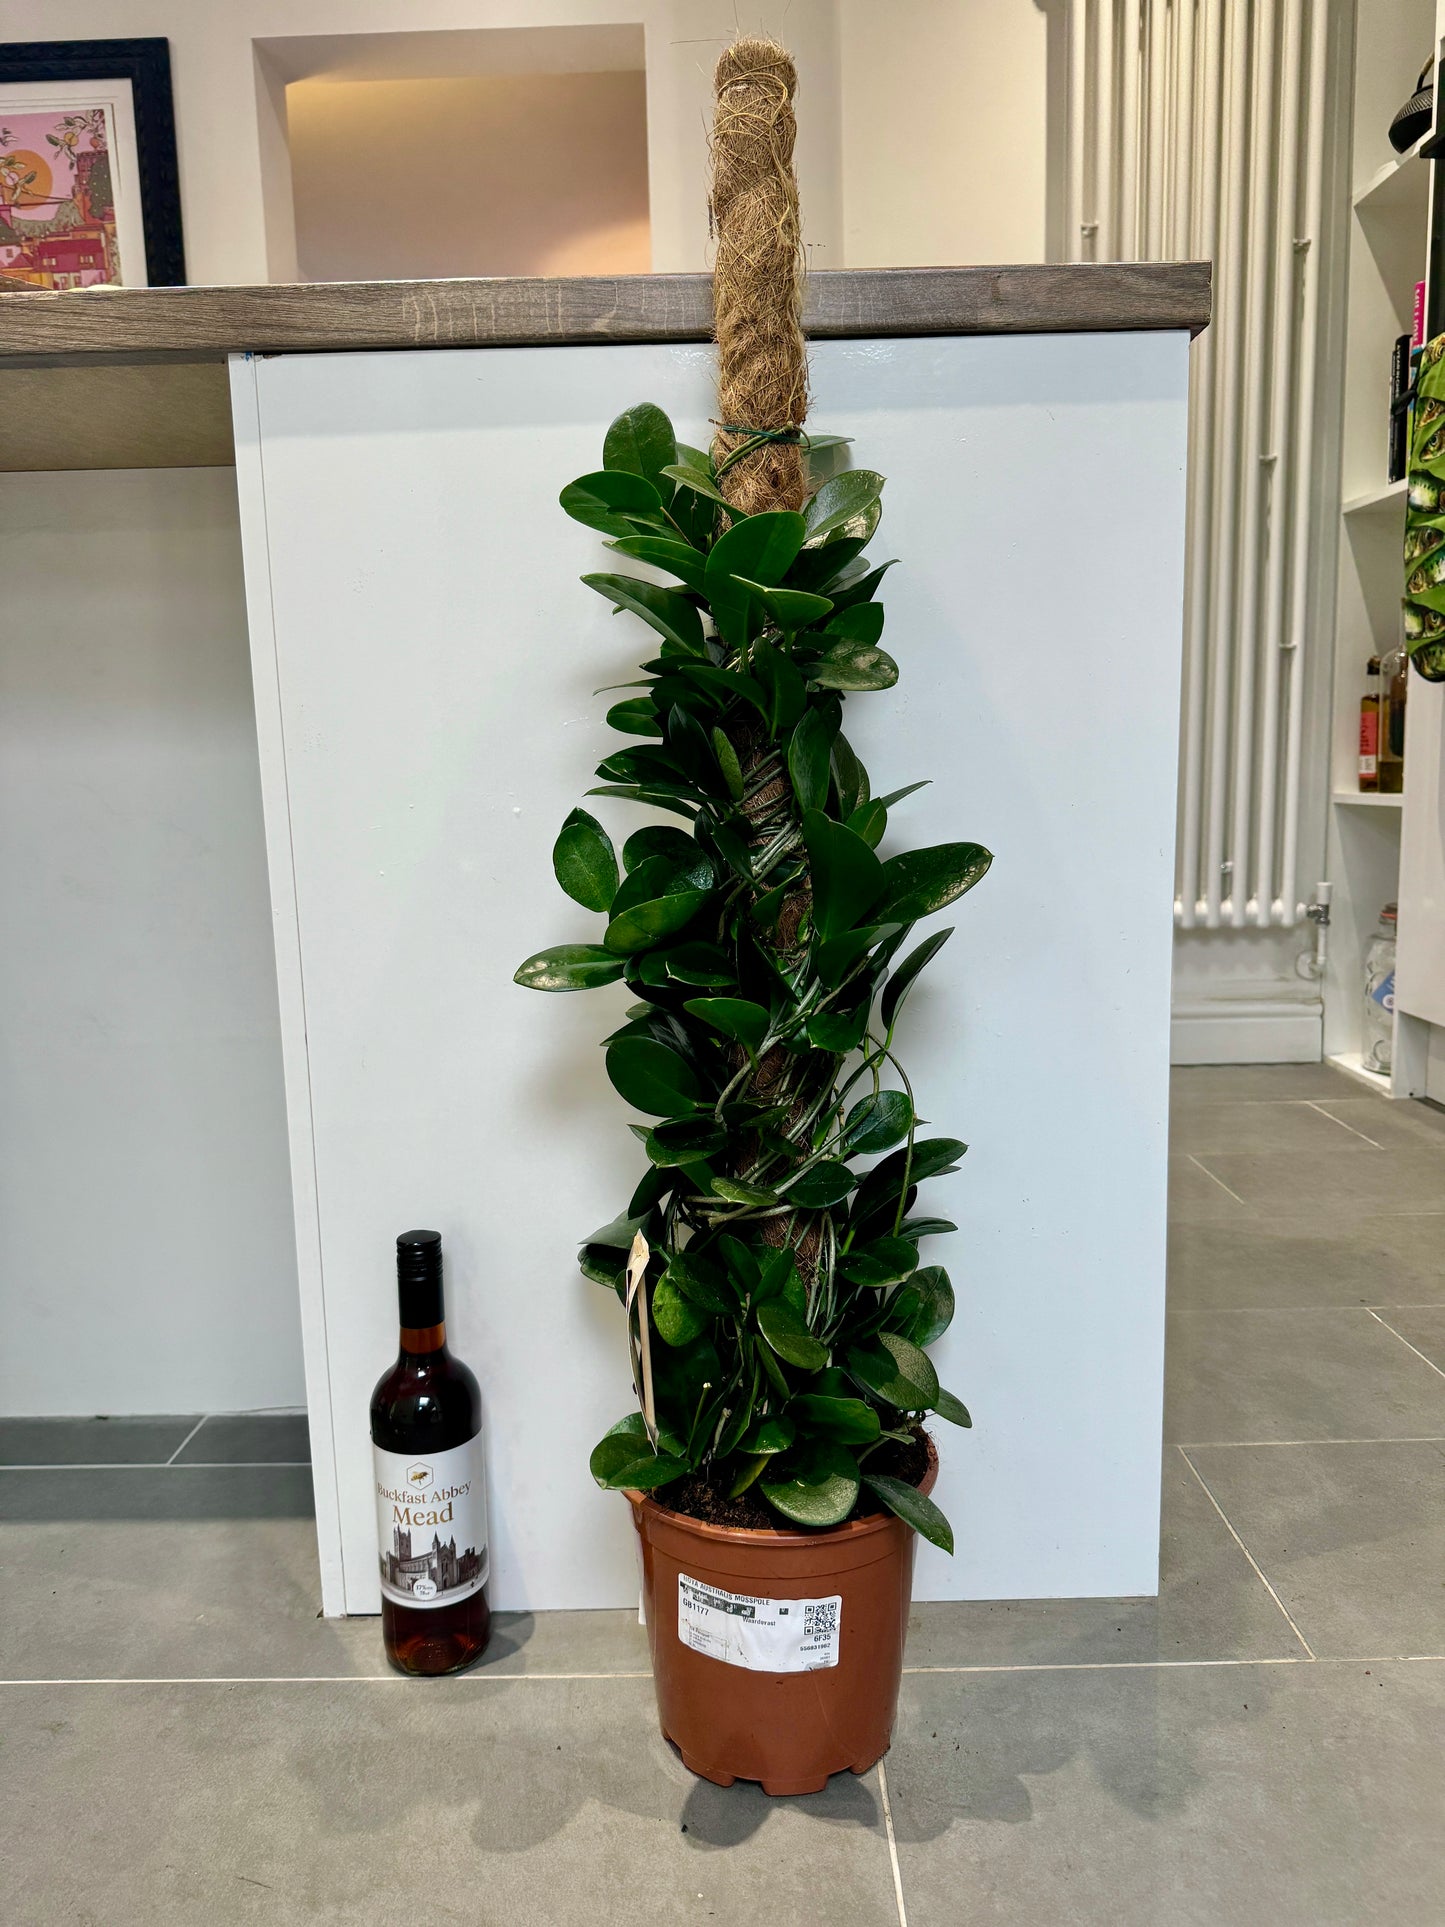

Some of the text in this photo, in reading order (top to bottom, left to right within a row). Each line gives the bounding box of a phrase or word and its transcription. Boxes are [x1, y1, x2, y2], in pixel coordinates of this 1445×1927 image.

[377, 1480, 471, 1504] Buckfast Abbey
[393, 1501, 454, 1526] Mead
[700, 1583, 733, 1600] AUSTRALIS
[734, 1595, 770, 1605] MOSSPOLE
[683, 1598, 709, 1616] GB1177
[742, 1616, 776, 1626] Waardevast
[814, 1634, 831, 1642] 6F35
